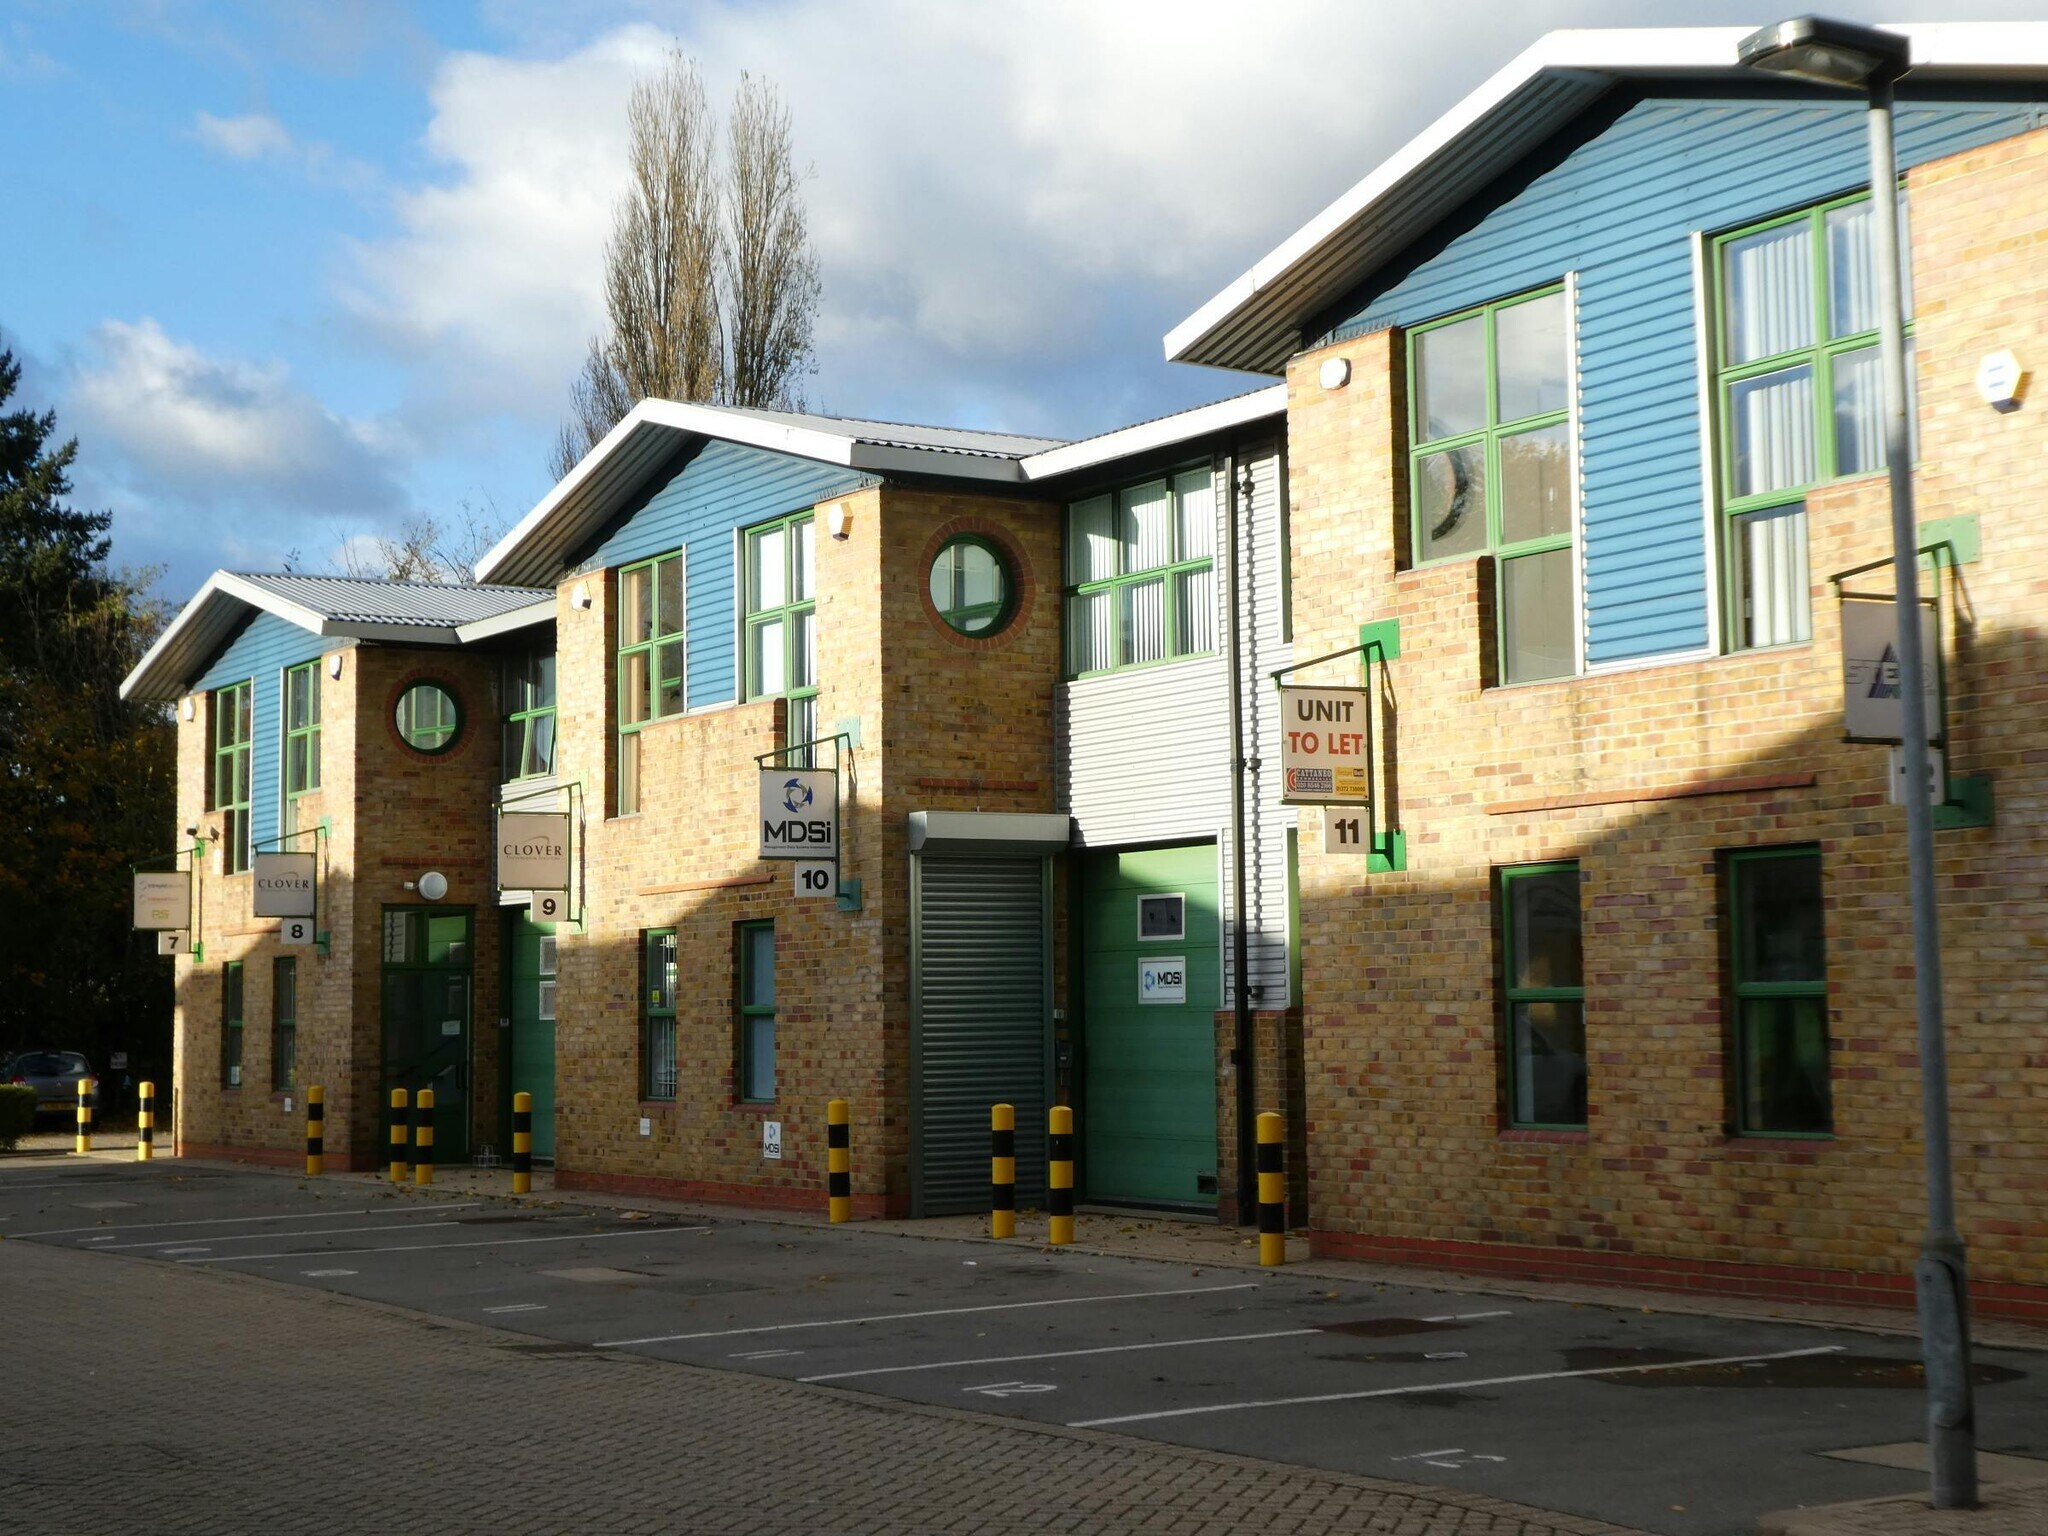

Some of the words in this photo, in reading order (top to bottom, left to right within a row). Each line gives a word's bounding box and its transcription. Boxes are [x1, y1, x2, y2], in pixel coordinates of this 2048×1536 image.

[1297, 699, 1354, 723] UNIT
[1287, 731, 1320, 755] TO
[1327, 732, 1364, 756] LET
[1296, 769, 1332, 778] CATTANEO
[764, 820, 832, 843] MDSi
[1334, 818, 1360, 845] 11
[503, 843, 562, 856] CLOVER
[257, 879, 310, 889] CLOVER
[801, 869, 829, 890] 10
[542, 898, 557, 916] 9
[291, 924, 304, 939] 8
[168, 936, 179, 950] 7
[1157, 971, 1182, 985] MDSi
